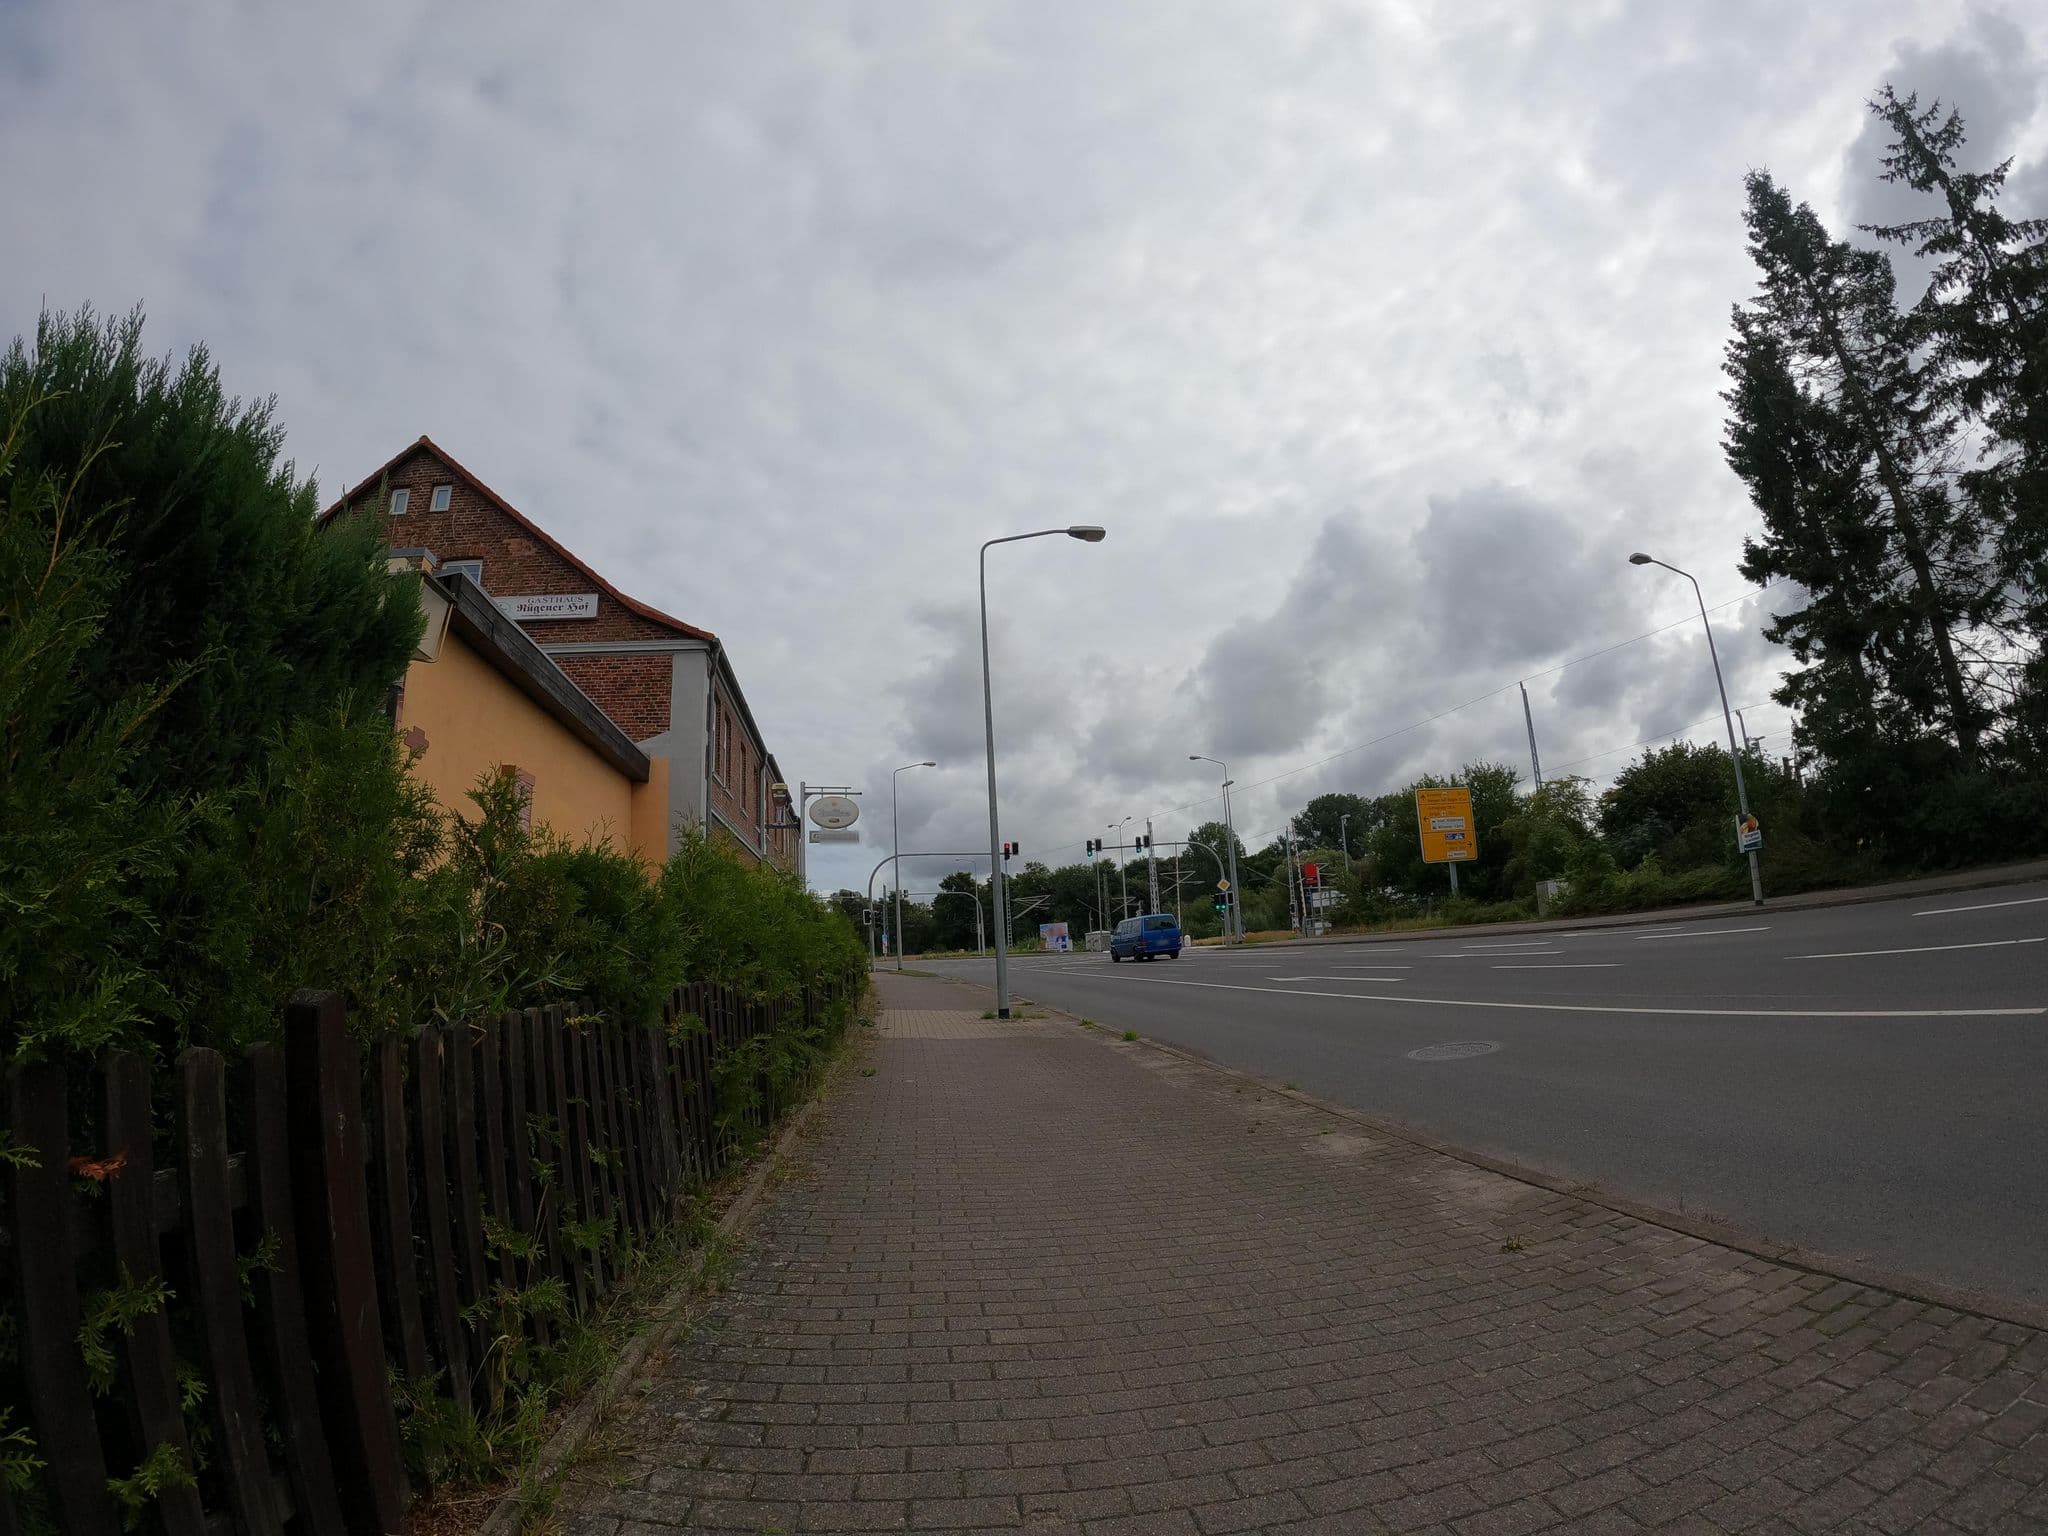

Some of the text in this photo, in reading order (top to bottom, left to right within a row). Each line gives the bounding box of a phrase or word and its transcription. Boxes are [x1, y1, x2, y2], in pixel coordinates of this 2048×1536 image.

[528, 596, 584, 604] GASTHAUS
[516, 602, 590, 614] Rügener Hof
